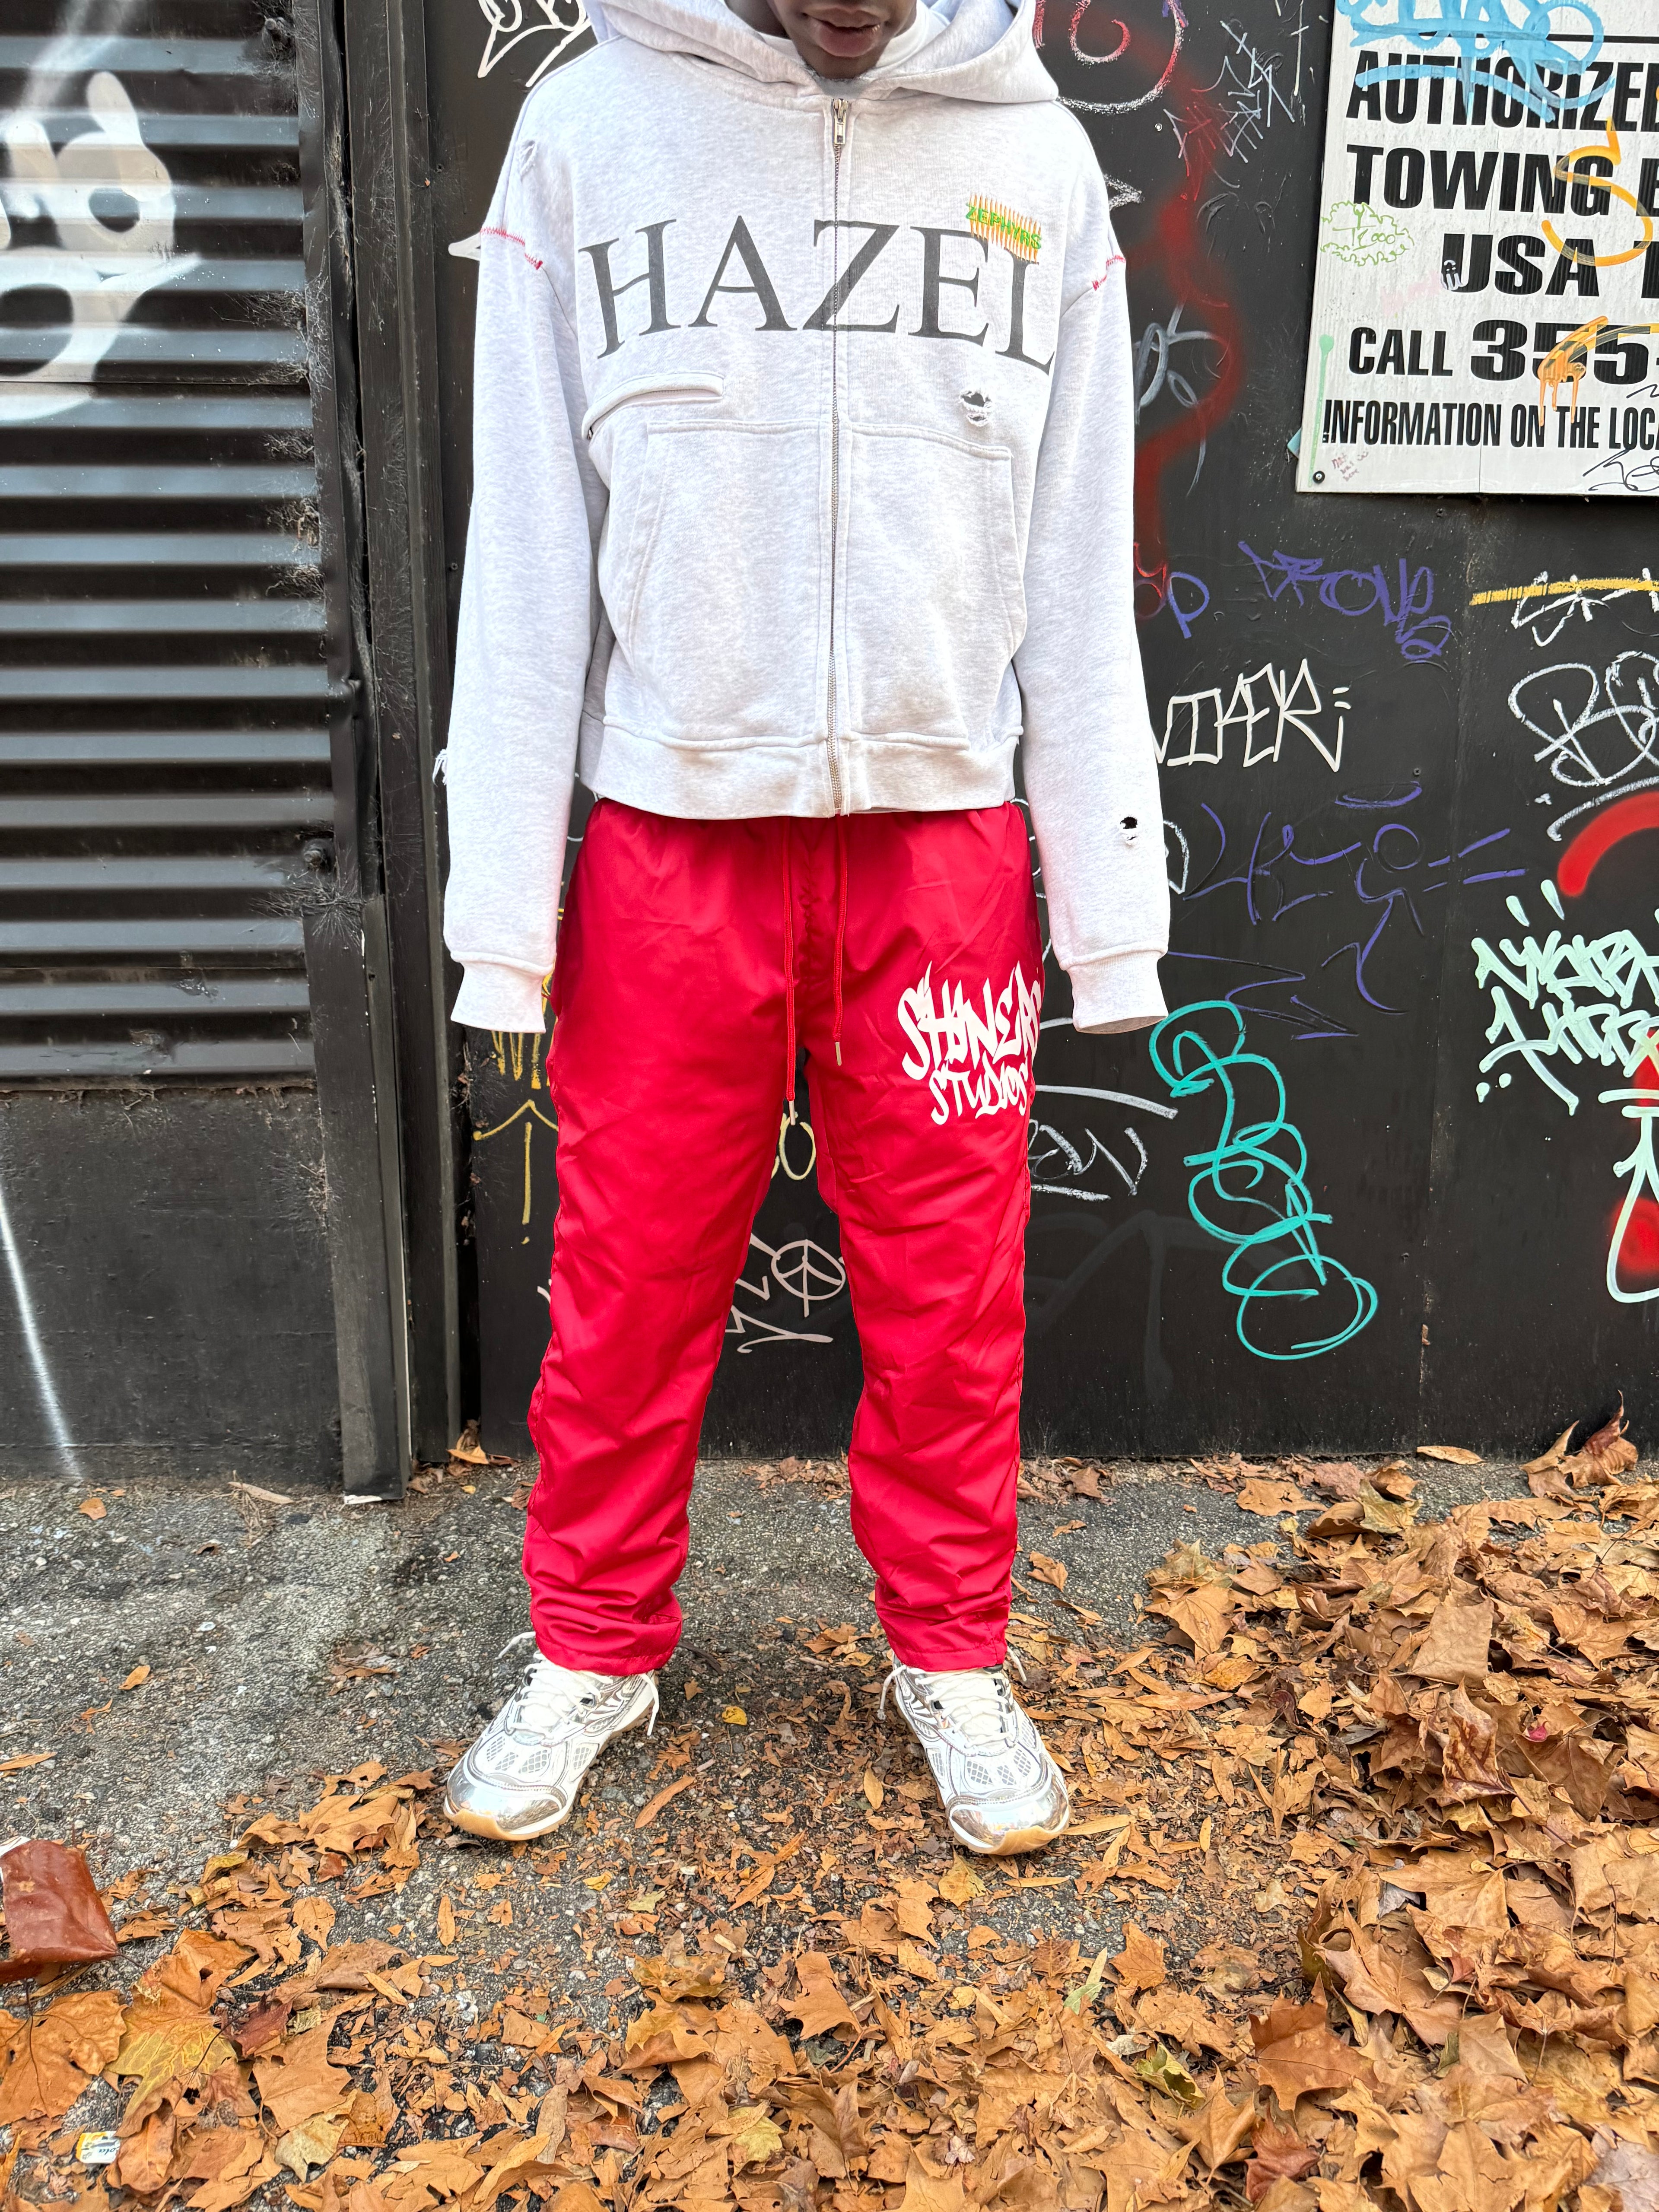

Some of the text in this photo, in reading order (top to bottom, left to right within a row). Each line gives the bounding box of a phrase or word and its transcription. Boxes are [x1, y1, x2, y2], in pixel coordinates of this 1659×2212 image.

[1347, 144, 1614, 216] TOWING
[966, 203, 1042, 249] ZEPHYRS
[578, 216, 1055, 375] HAZEL
[1440, 233, 1599, 297] USA
[1349, 319, 1659, 385] CALL 355
[1322, 399, 1659, 450] INFORMATION ON THE LOC
